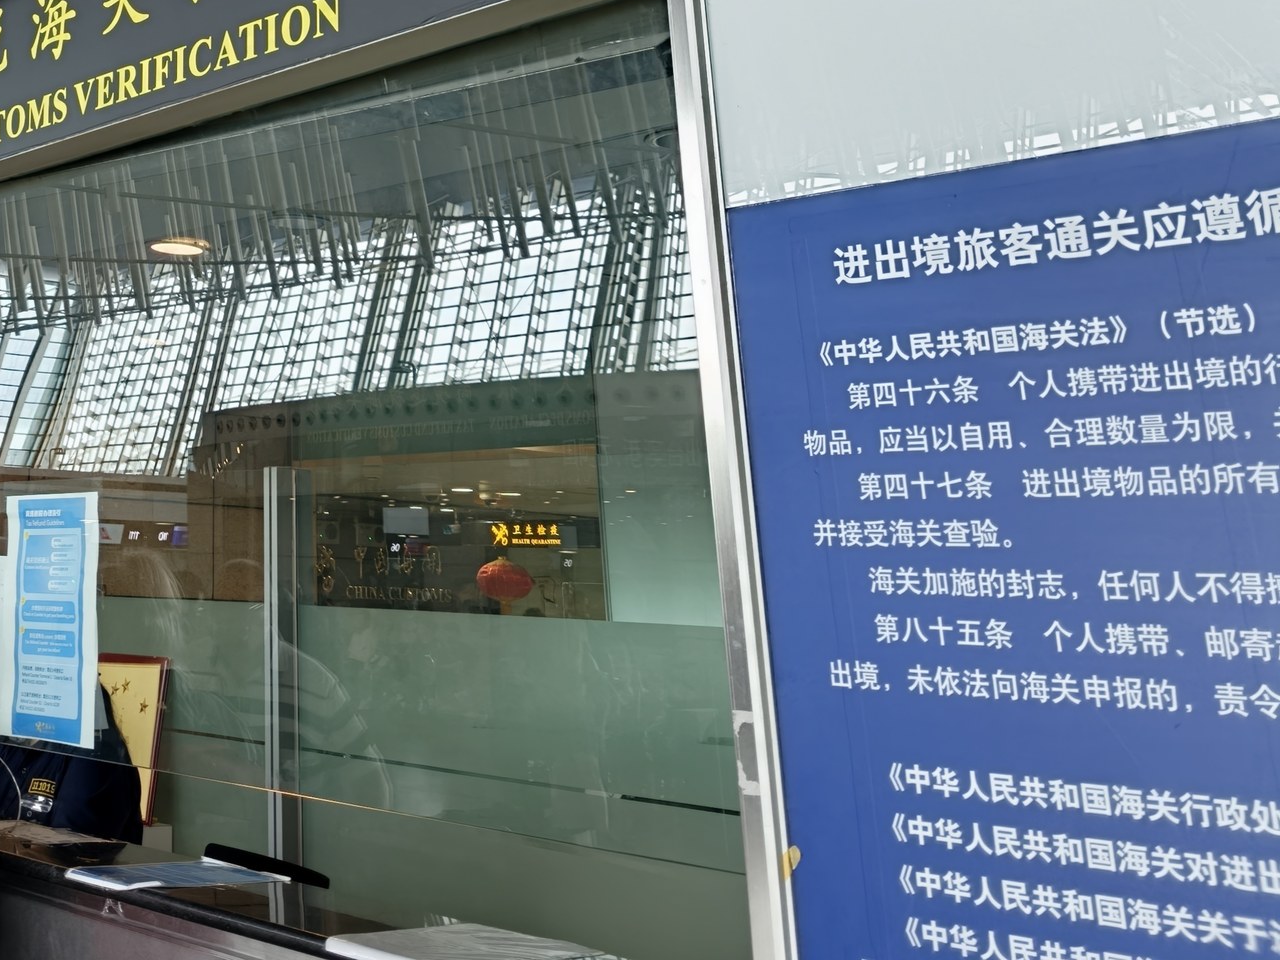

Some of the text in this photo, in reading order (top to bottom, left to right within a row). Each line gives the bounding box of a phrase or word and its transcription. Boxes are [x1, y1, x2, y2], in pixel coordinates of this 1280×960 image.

[847, 375, 979, 410] 第四十六条
[858, 470, 992, 501] 第四十七条
[346, 585, 386, 600] CHINA
[874, 613, 1013, 650] 第八十五条
